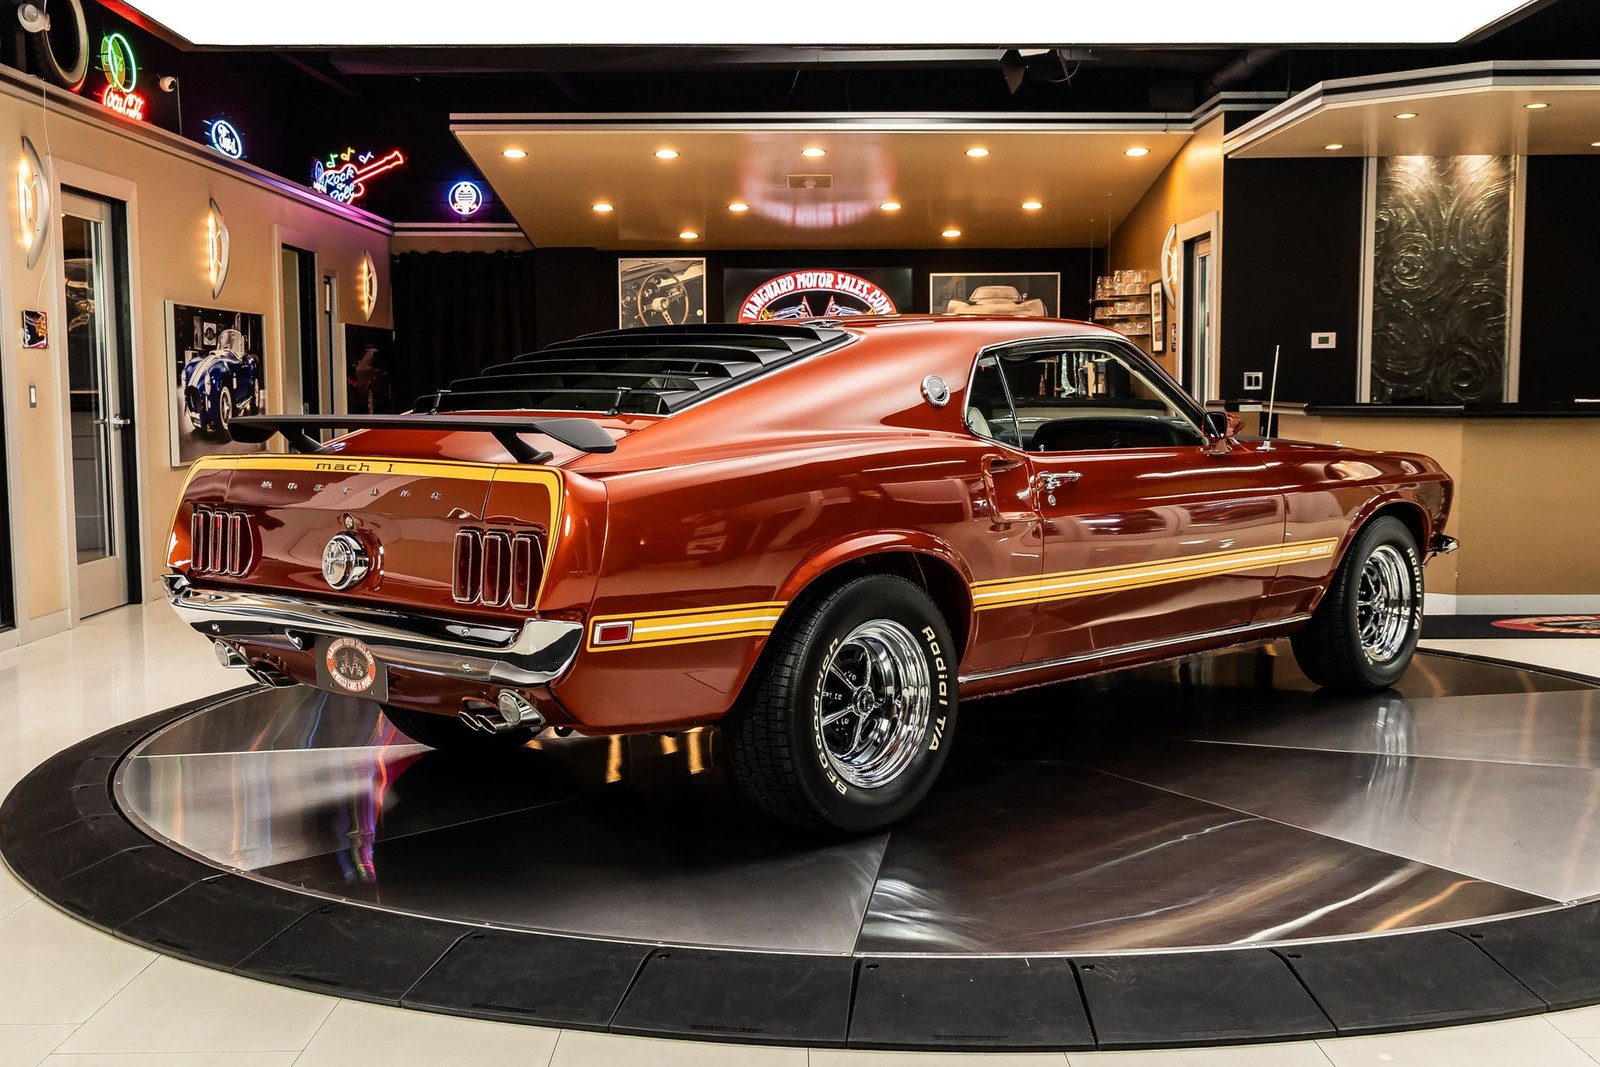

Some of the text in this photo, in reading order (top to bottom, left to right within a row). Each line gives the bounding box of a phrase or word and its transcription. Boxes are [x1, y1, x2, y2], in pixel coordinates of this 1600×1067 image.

[325, 166, 355, 187] Rock
[742, 272, 893, 320] VANGUARD MOTOR SALES.COM
[315, 462, 394, 473] mach 1
[1407, 547, 1422, 630] Radial T/A
[921, 625, 948, 751] Radial T/A
